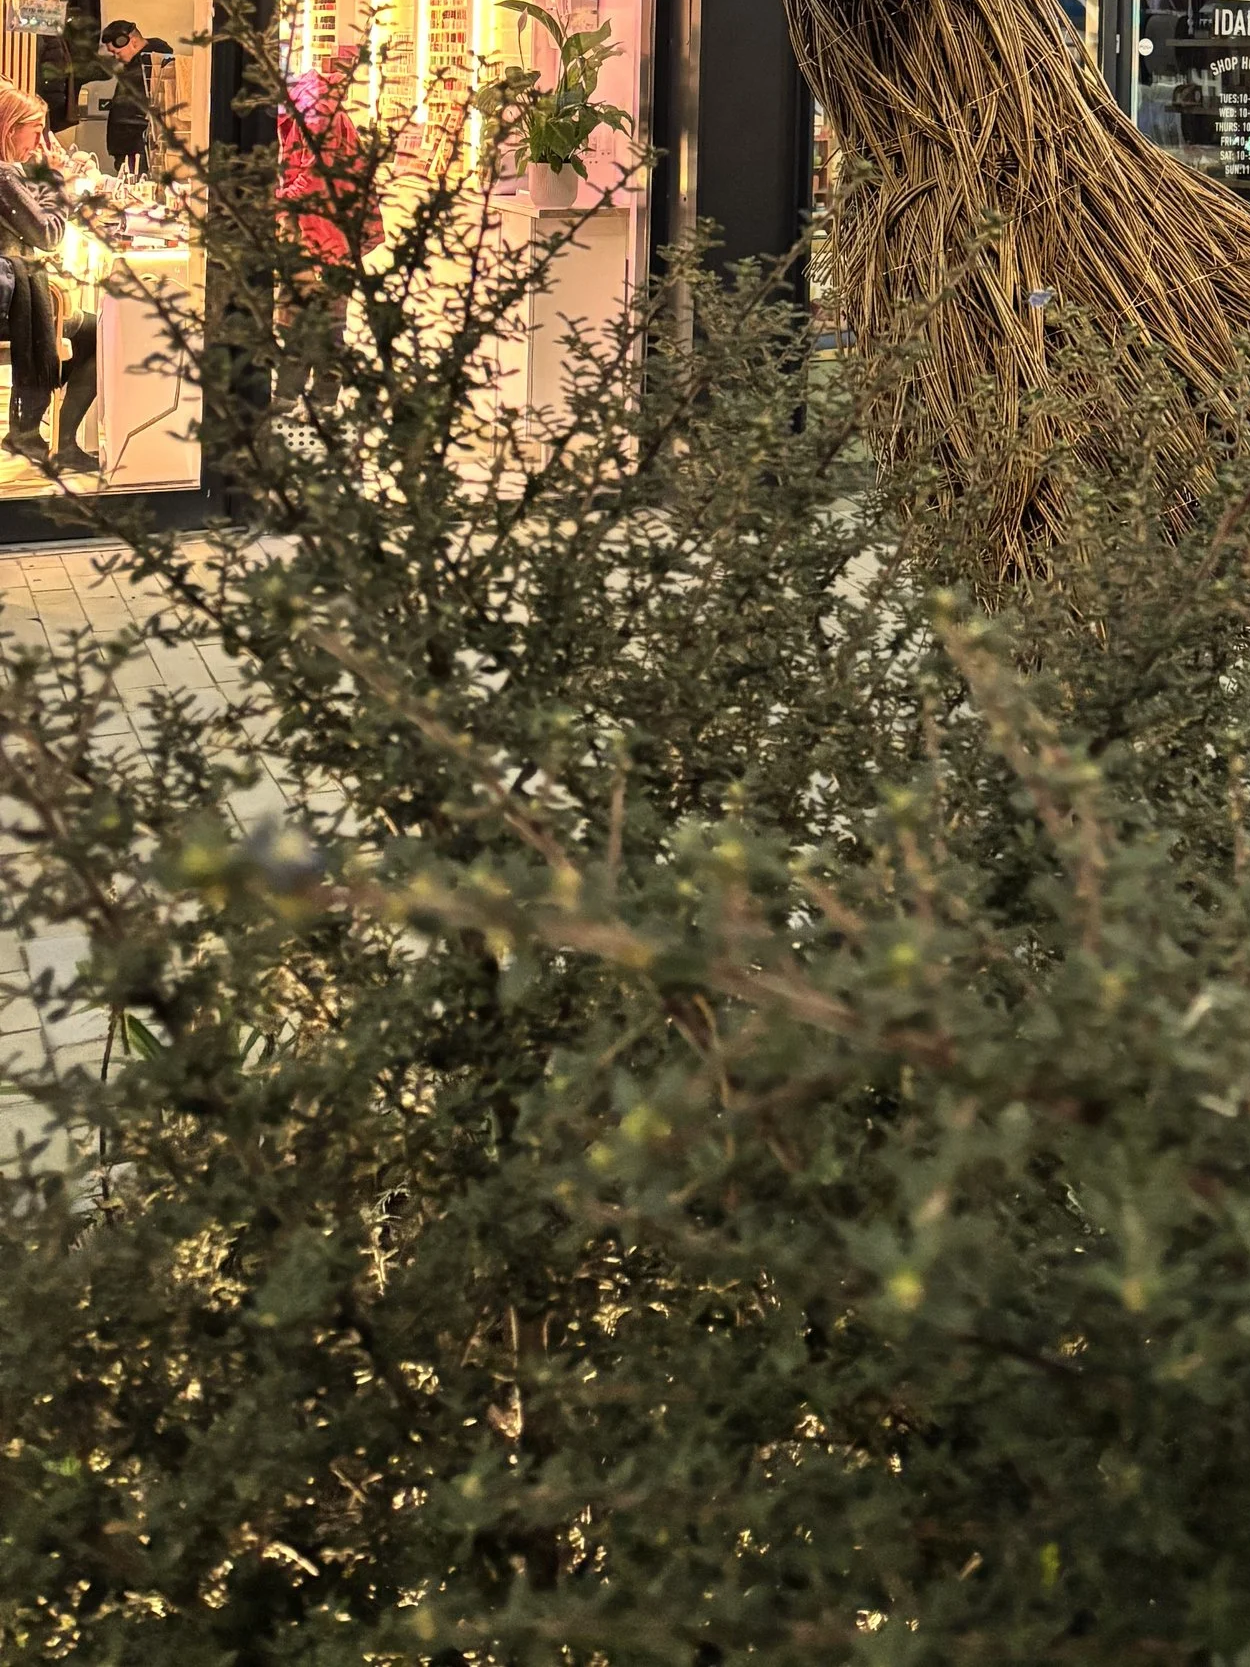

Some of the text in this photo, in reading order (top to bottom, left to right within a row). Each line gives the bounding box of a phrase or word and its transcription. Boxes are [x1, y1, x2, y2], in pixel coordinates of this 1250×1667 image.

[1210, 56, 1239, 76] SHOP
[1218, 107, 1237, 118] WED:
[1215, 121, 1240, 133] THURS:
